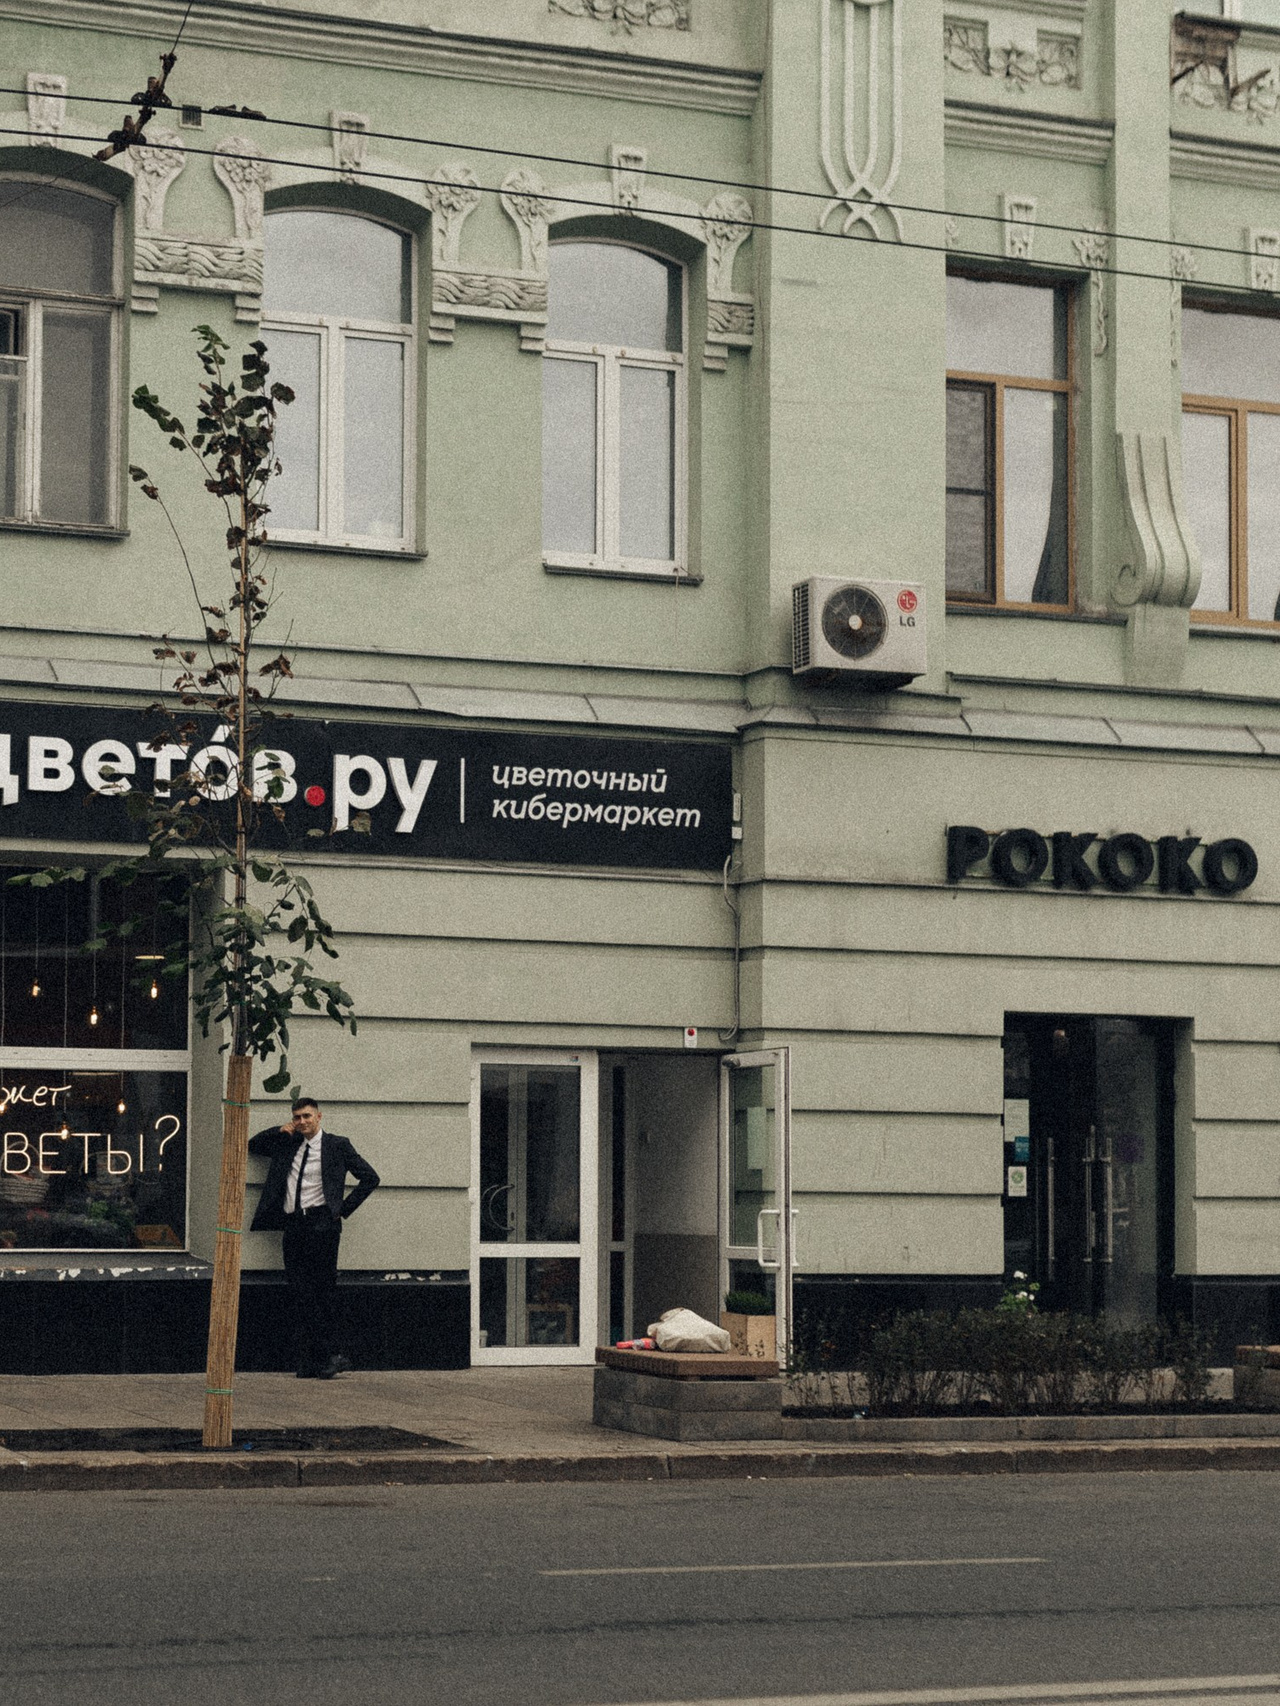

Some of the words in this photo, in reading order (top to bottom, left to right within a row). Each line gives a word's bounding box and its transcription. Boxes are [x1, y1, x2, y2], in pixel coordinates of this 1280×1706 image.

[899, 616, 916, 627] LG
[492, 764, 668, 793] цветочный
[492, 793, 701, 831] кибермаркет
[946, 825, 1259, 898] РОКОКО
